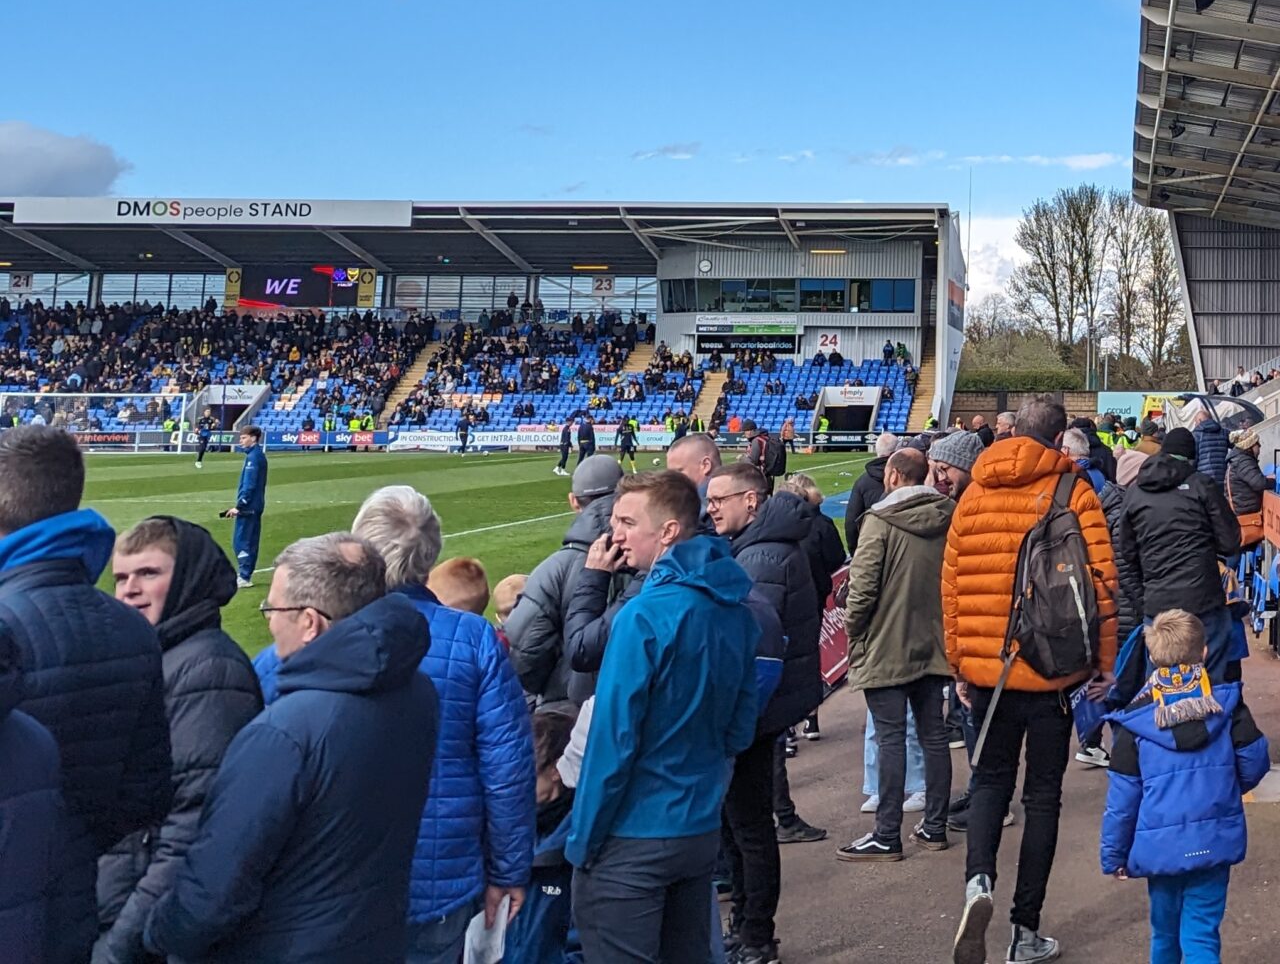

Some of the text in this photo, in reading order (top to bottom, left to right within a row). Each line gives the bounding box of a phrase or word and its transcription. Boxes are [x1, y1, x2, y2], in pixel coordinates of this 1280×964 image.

[117, 200, 312, 220] DMOS people STAND
[265, 278, 302, 295] WE
[594, 277, 613, 291] 23
[819, 333, 838, 347] 24
[282, 432, 320, 444] sky bet
[335, 432, 373, 444] sky bet
[490, 435, 559, 443] INTRA-BUILD.COM
